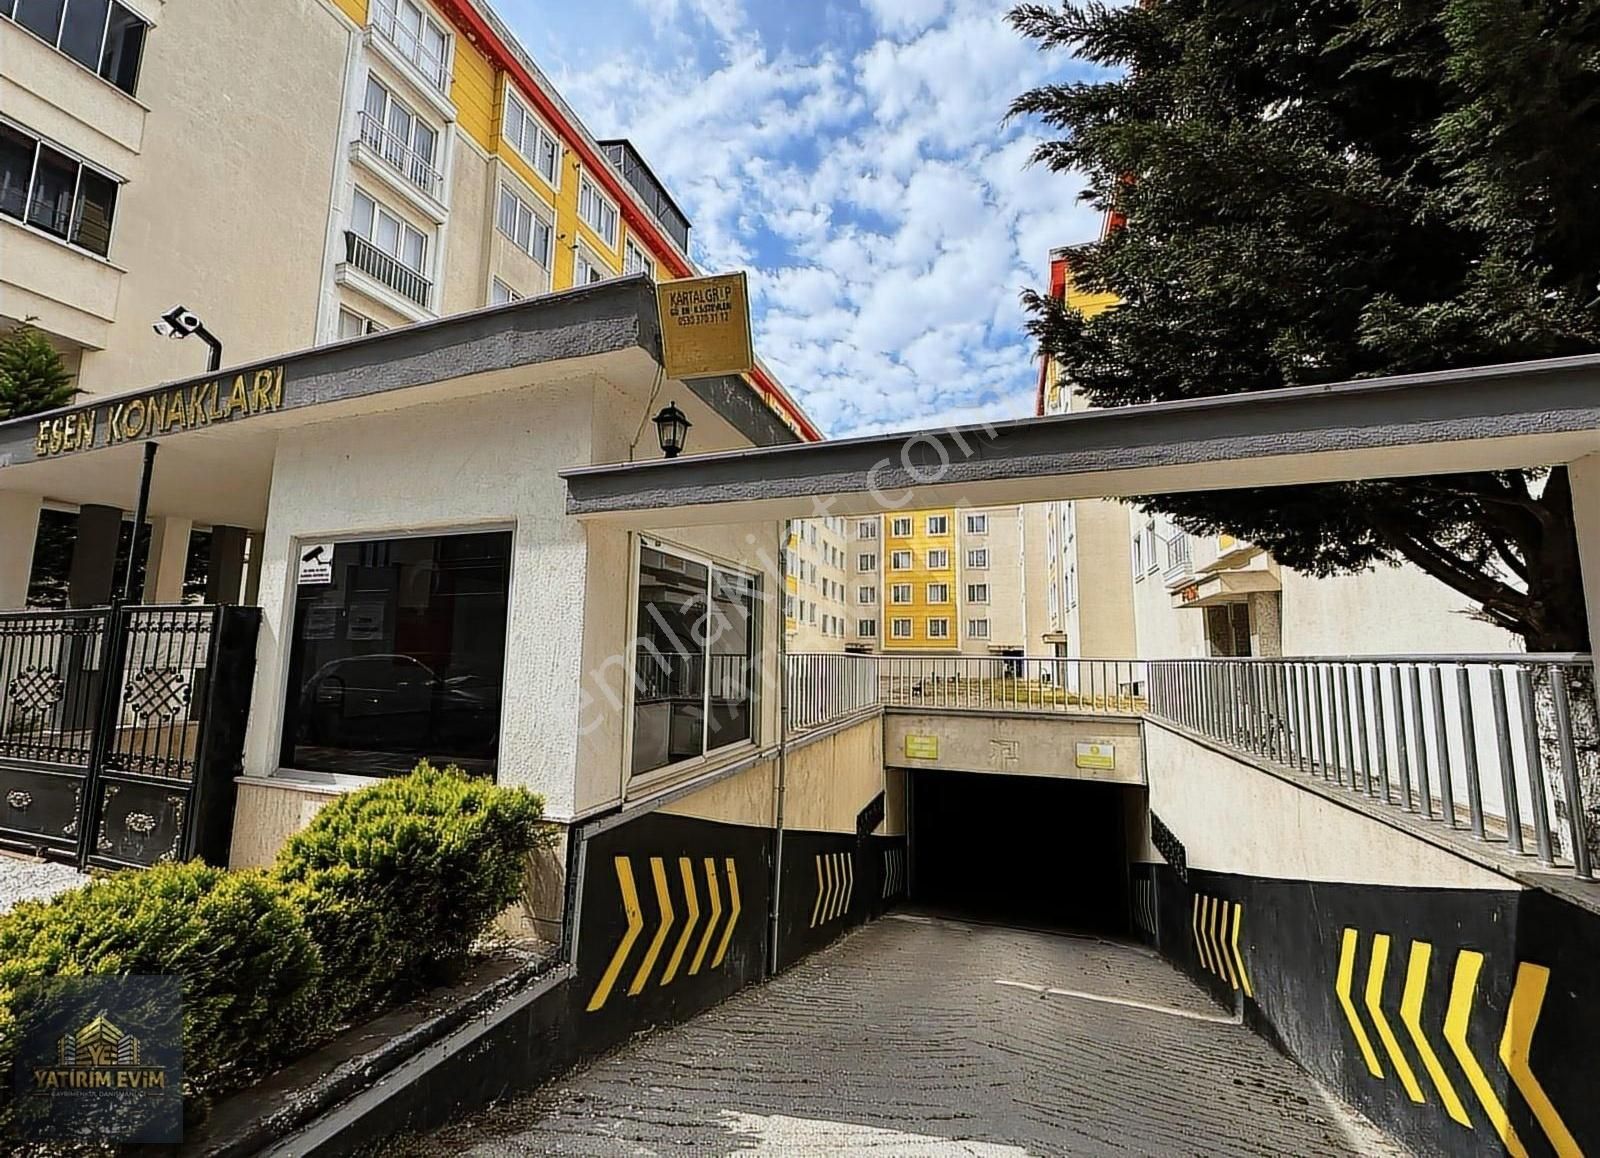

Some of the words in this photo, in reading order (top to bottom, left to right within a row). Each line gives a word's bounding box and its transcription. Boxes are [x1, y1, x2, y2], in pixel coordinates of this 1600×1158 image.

[670, 290, 705, 305] KARTAL
[35, 409, 96, 456] ESEN
[106, 364, 285, 445] KONAKLARI
